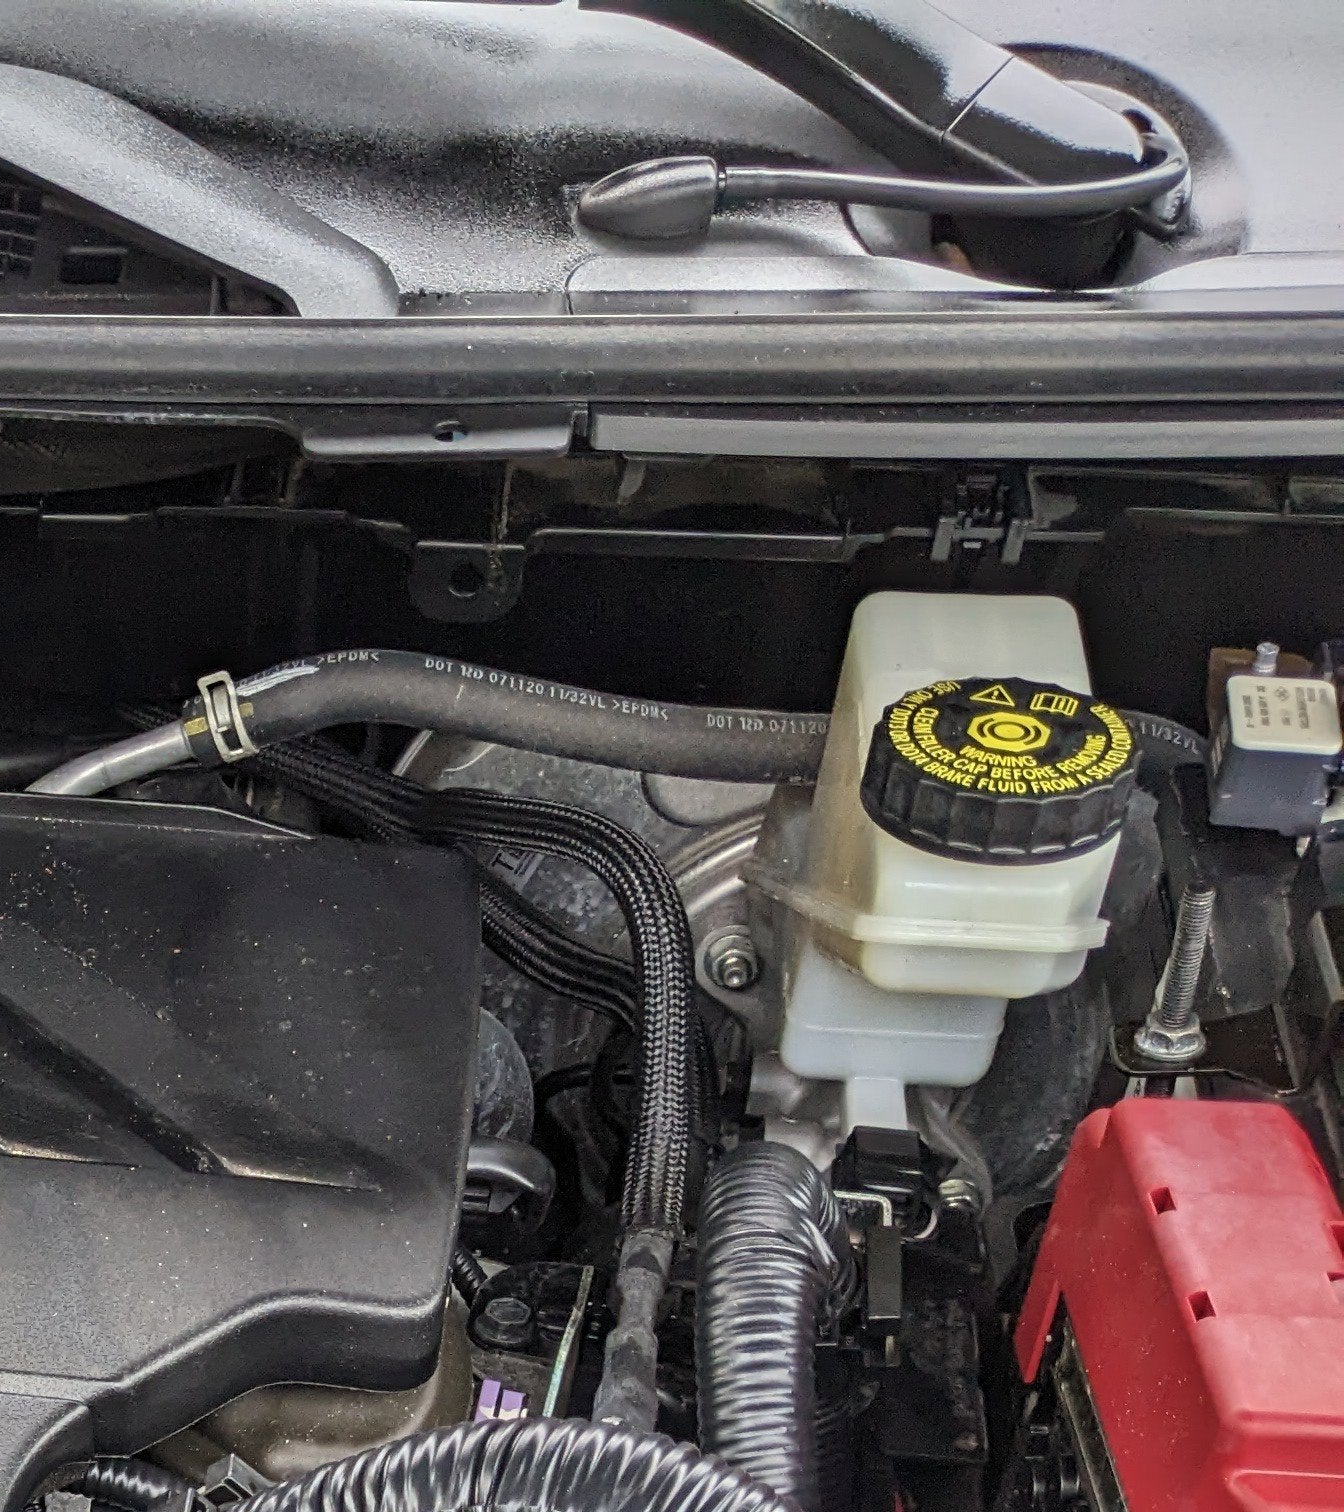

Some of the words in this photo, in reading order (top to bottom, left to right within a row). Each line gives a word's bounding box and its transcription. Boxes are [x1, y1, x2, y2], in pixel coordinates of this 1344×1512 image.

[425, 657, 453, 673] DOT
[706, 713, 732, 730] DOT
[913, 707, 939, 734] CLEAN
[1089, 704, 1132, 750] CONTAINER
[914, 735, 956, 763] FILLER
[959, 745, 1037, 767] WARNING
[1056, 734, 1106, 774] REMOVING
[923, 761, 976, 787] BRAKE
[953, 758, 988, 774] CAP
[990, 765, 1060, 780] BEFORE
[1086, 749, 1128, 780] SEALED
[977, 777, 1027, 794] FLUID
[1030, 776, 1079, 794] FROM
[1076, 774, 1093, 785] A
